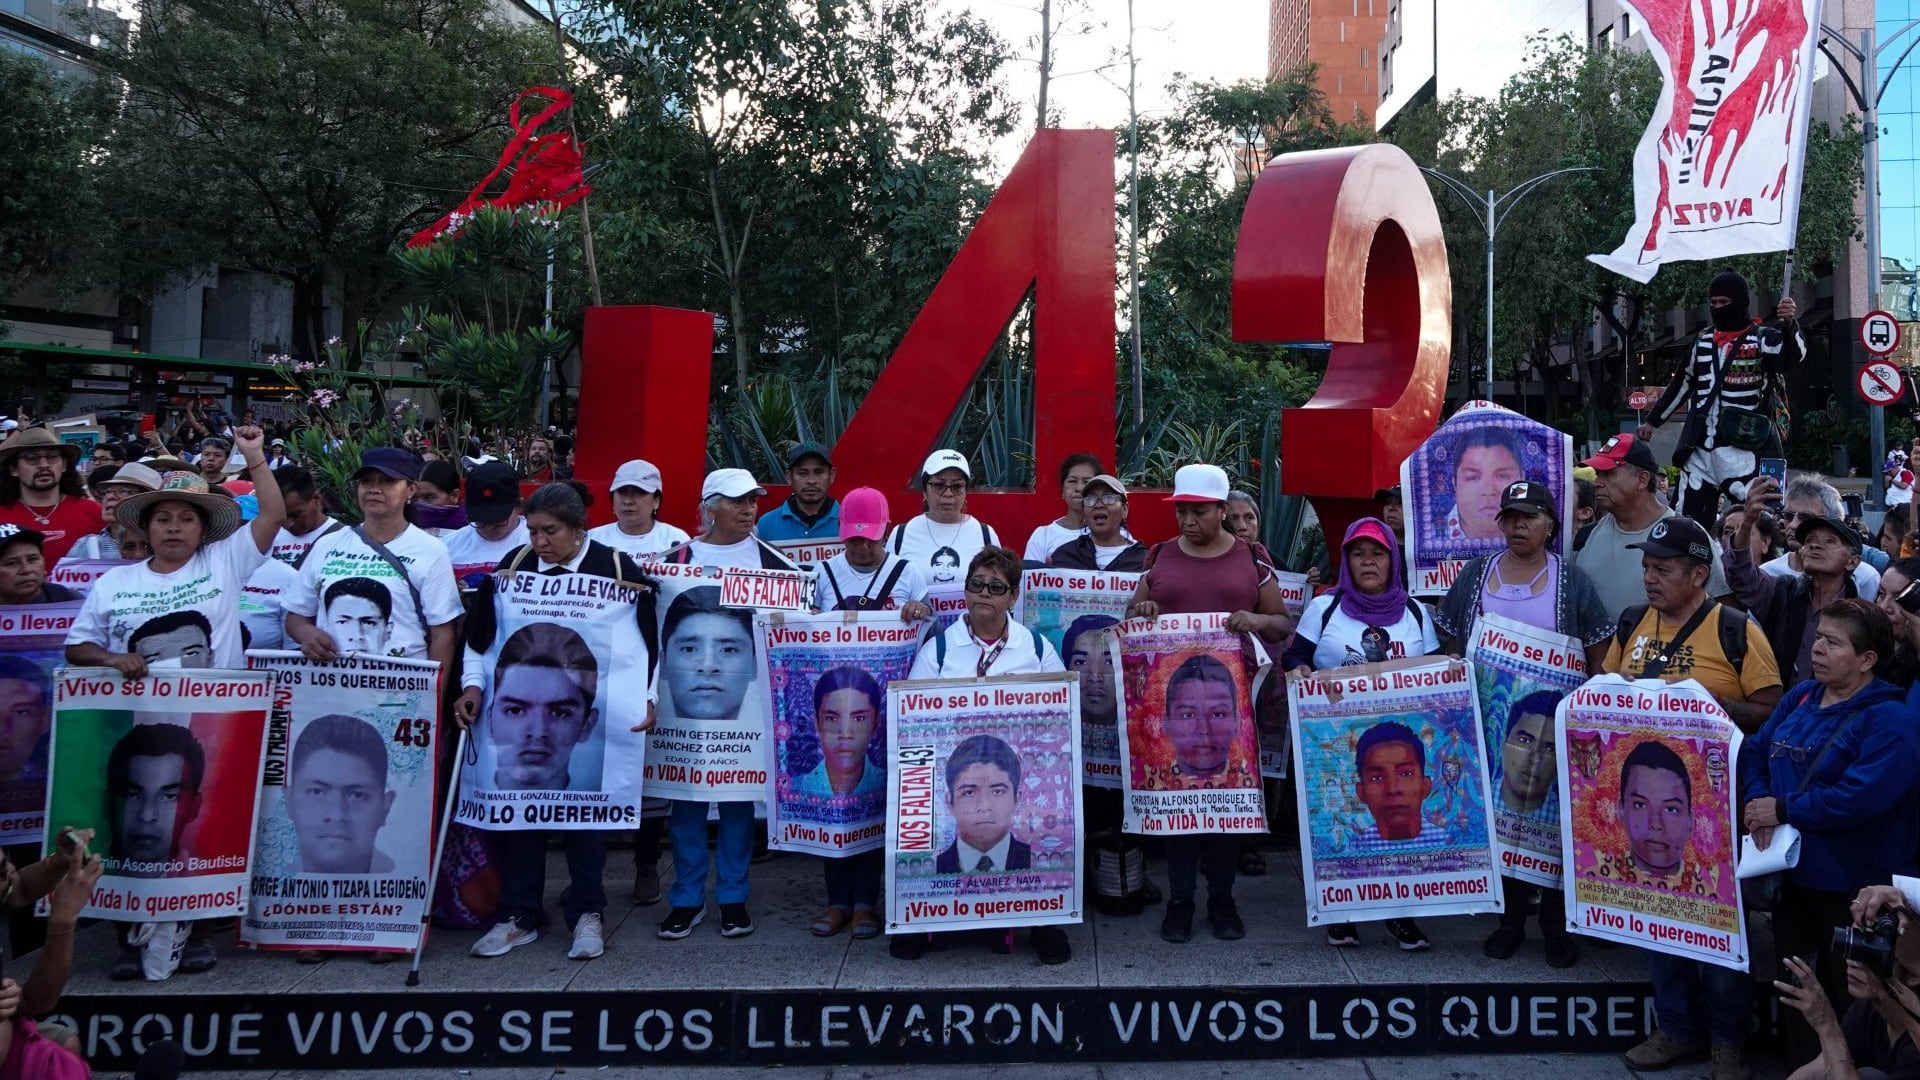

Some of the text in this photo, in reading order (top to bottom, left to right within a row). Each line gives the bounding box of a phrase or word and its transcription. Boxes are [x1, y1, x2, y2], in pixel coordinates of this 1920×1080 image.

[1629, 397, 1648, 406] ALTO
[799, 550, 812, 561] lo
[685, 566, 702, 577] se
[1027, 572, 1106, 590] ¡Vivo se lo
[513, 574, 536, 594] SE
[540, 577, 562, 597] LO
[721, 577, 817, 611] NOS FALTAN 43
[540, 599, 594, 610] desaparecido
[1161, 617, 1180, 631] se
[1187, 616, 1202, 631] lo
[768, 623, 921, 648] ¡Vivo se lo llevaron!
[1480, 630, 1564, 667] ¡Vivo se lo
[58, 677, 271, 701] ¡Vivo se lo llevaron!
[311, 672, 430, 691] LOS QUEREMOS!!!
[1298, 679, 1344, 699] ¡Vivo
[1349, 678, 1367, 694] se
[1372, 675, 1388, 691] lo
[1393, 666, 1468, 690] llevaron!
[901, 687, 1068, 715] ¡Vivo se lo llevaron!
[1569, 689, 1653, 710] ¡Vivo se lo
[394, 718, 431, 748] 43
[689, 730, 763, 741] GETSEMANY
[706, 741, 752, 753] GARCÍA
[665, 755, 740, 765] EDAD 20 AÑOS
[658, 764, 687, 783] VIDA
[690, 766, 702, 784] lo
[487, 792, 518, 801] MANUEL
[901, 766, 933, 816] FALTAN
[1161, 794, 1199, 806] ALFONSO
[1201, 790, 1246, 804] RODRÍGUEZ
[490, 805, 515, 824] LO
[524, 805, 636, 825] QUEREMOS
[1152, 807, 1185, 815] Clemente
[784, 823, 829, 844] ¡Vivo lo
[1141, 815, 1163, 833] ¡Con
[1167, 814, 1199, 831] VIDA
[1203, 814, 1215, 829] lo
[901, 820, 931, 850] NOS
[122, 855, 246, 872] Ascencio Bautista
[1367, 855, 1391, 867] LUIS
[1398, 854, 1423, 866] LUNA
[281, 878, 329, 899] ANTONIO
[332, 879, 370, 899] TIZAPA
[374, 876, 427, 900] LEGIDEÑO
[1016, 875, 1042, 886] NAVA
[127, 891, 140, 911] lo
[146, 886, 243, 915] queremos!
[1322, 876, 1489, 906] ¡Con VIDA lo queremos!
[1578, 882, 1620, 897] CHRISTIAN
[1702, 905, 1737, 920] TELUMBRE
[262, 902, 403, 918] ¿DÓNDE ESTÁN?
[904, 894, 1065, 923] ¡Vivo lo queremos!
[1586, 906, 1732, 953] ¡Vivo lo queremos!
[287, 1009, 475, 1056] VIVOS
[498, 1009, 576, 1055] SE
[598, 1008, 714, 1053] LOS
[1109, 998, 1286, 1044] VIVOS
[1308, 996, 1418, 1042] LOS
